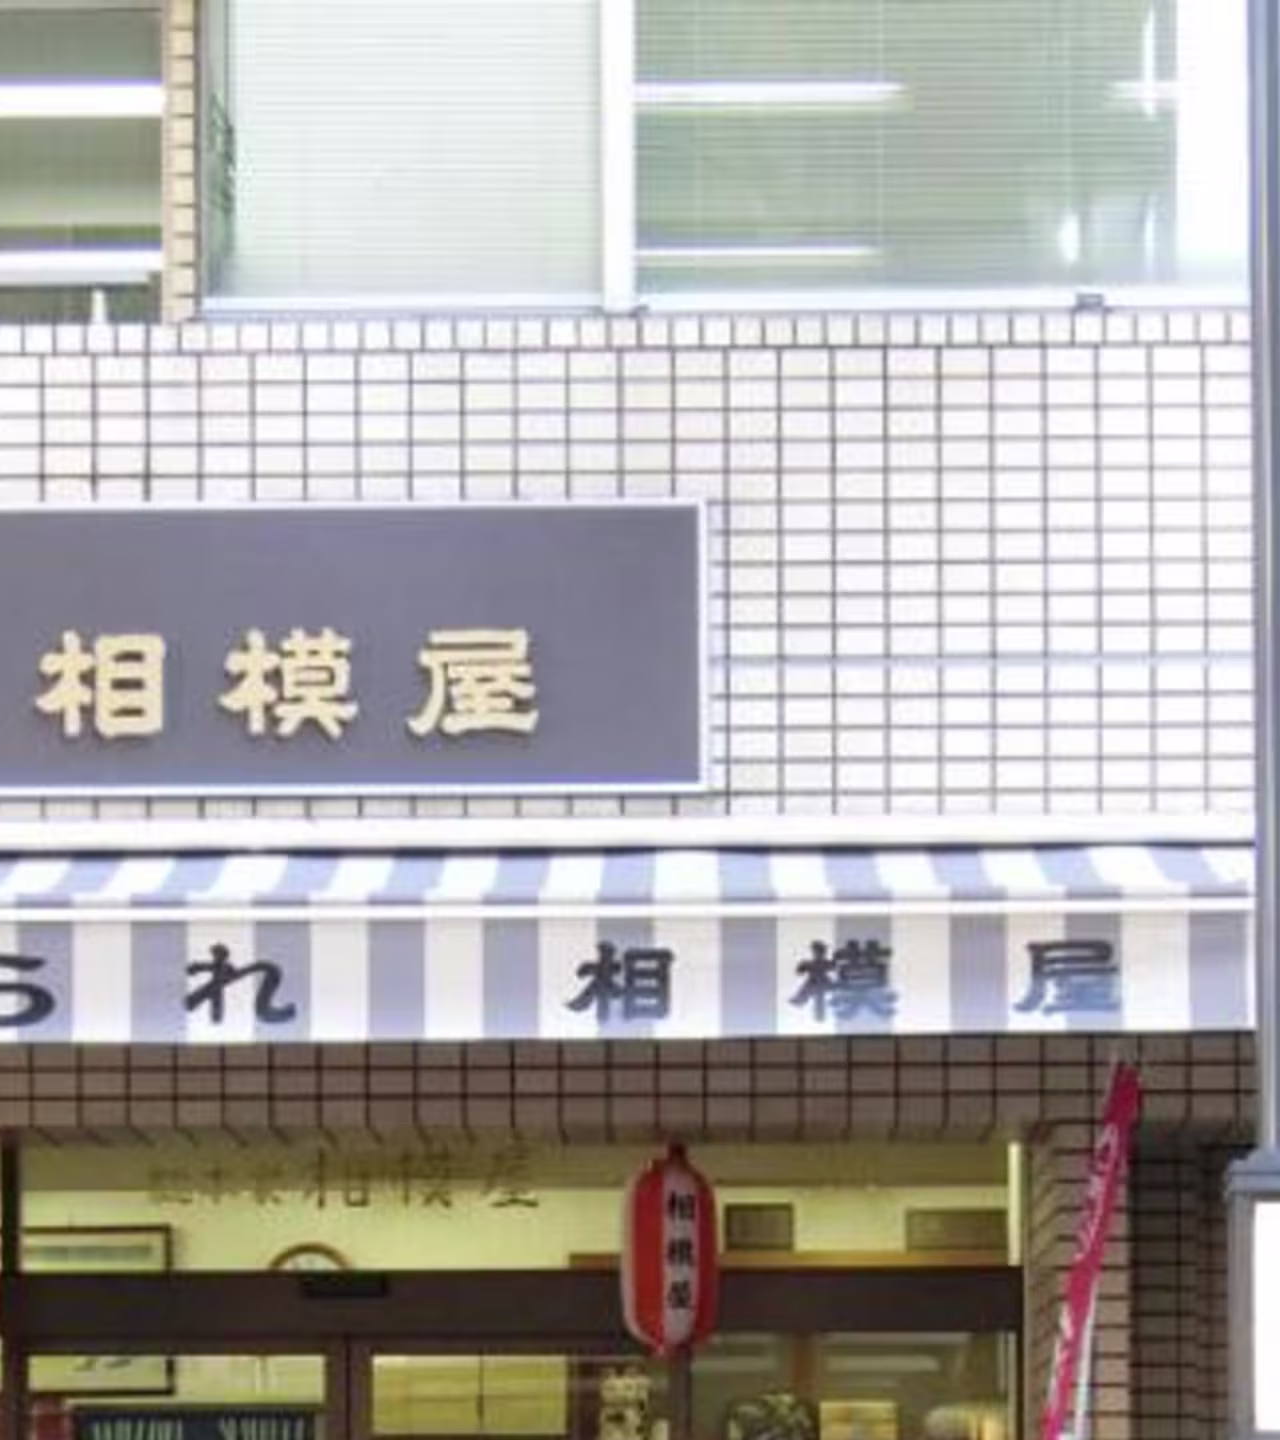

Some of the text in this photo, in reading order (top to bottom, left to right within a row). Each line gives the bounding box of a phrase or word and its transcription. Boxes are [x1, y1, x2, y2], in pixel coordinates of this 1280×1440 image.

[36, 628, 539, 739] 相模屋
[566, 939, 1122, 1020] 相模屋
